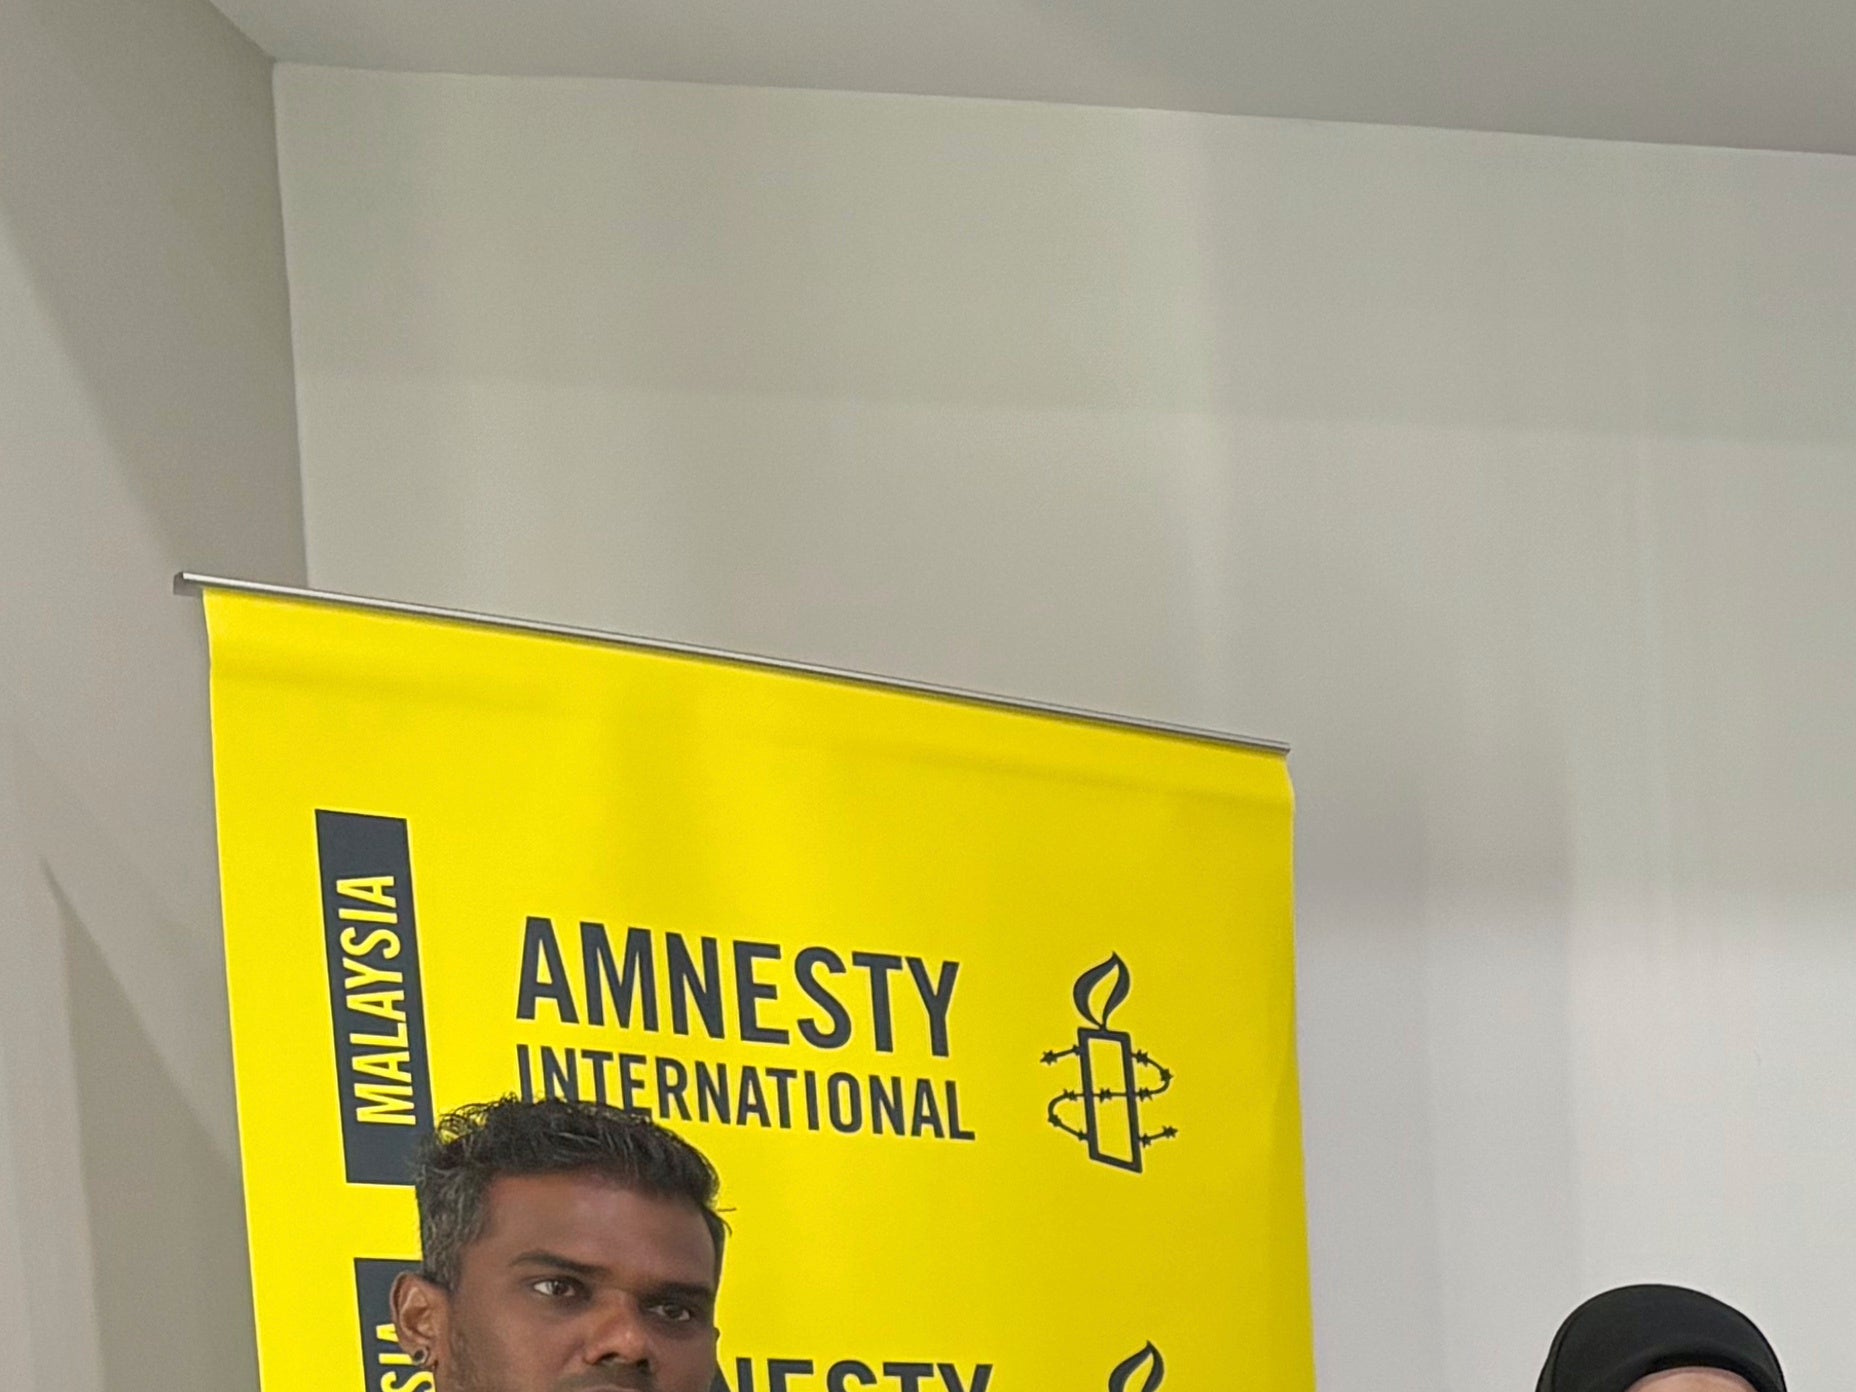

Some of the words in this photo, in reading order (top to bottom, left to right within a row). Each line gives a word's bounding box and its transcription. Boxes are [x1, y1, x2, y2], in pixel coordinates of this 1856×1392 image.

[336, 876, 416, 1126] MALAYSIA
[515, 916, 961, 1058] AMNESTY
[515, 1043, 976, 1142] INTERNATIONAL
